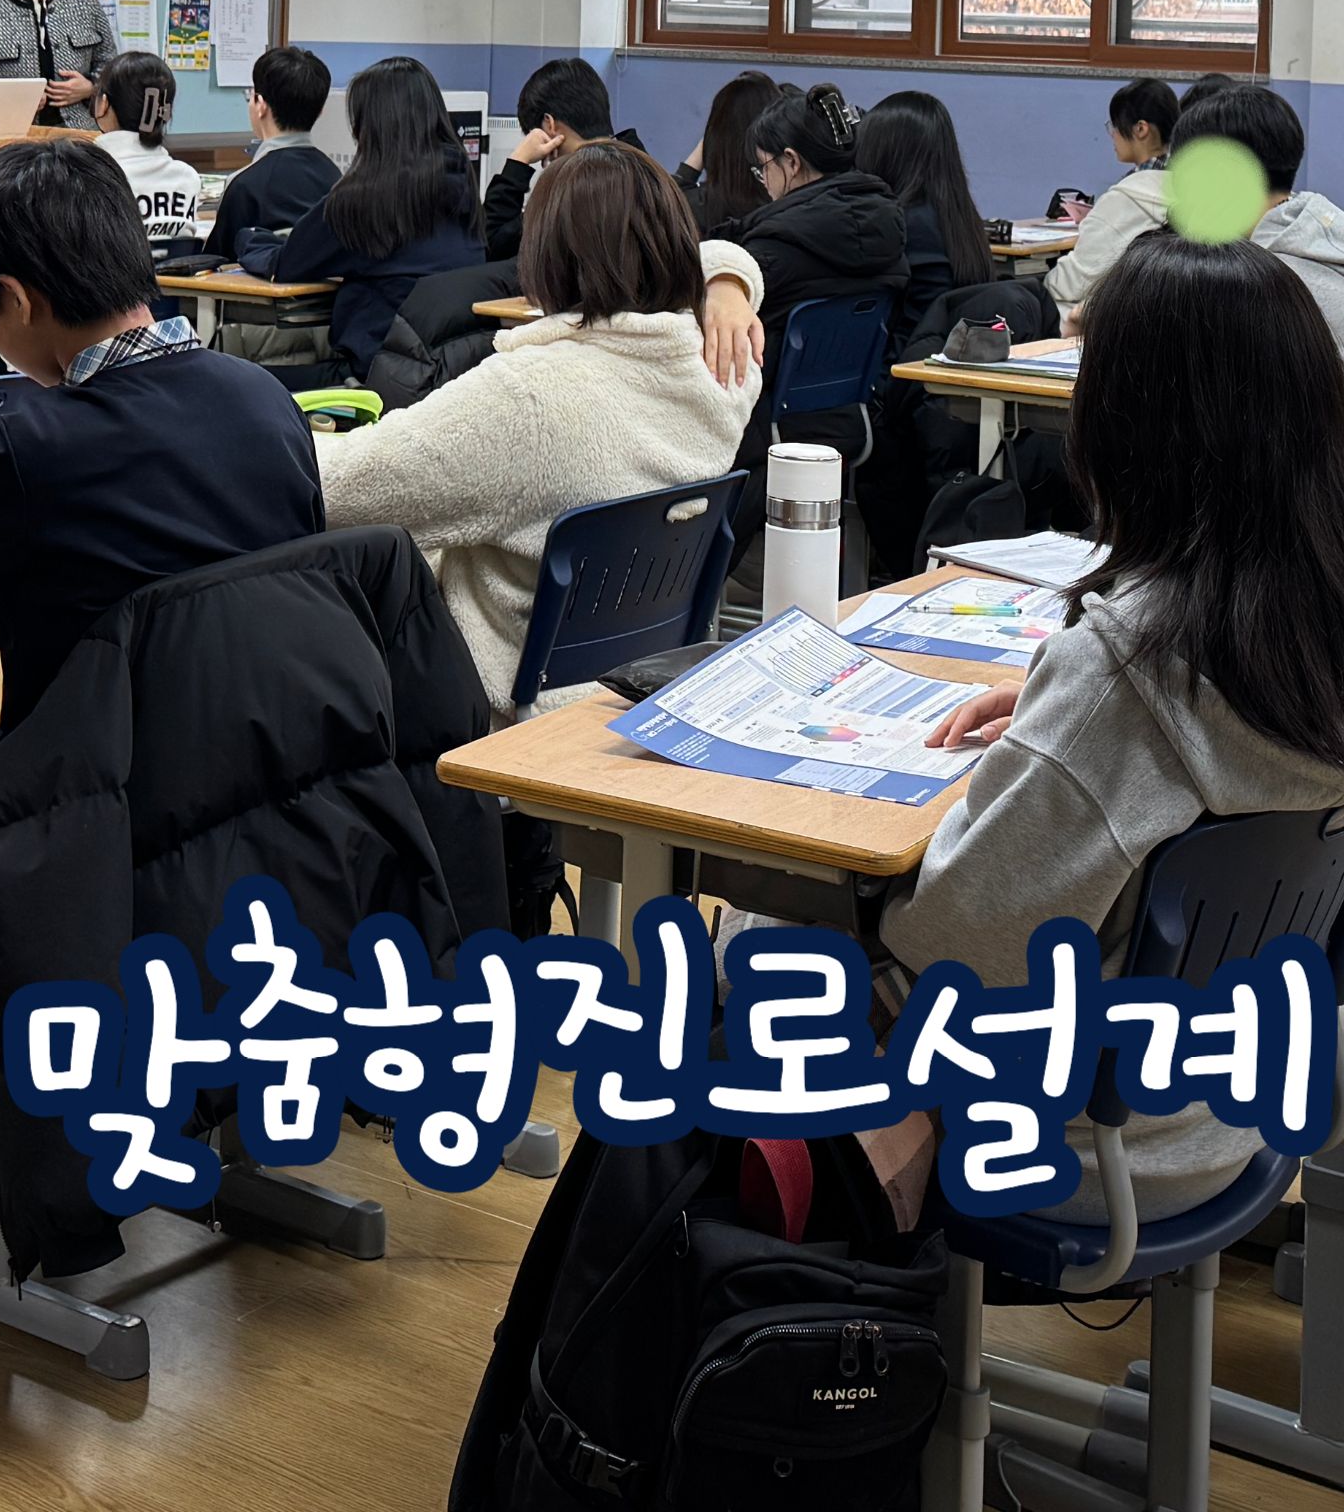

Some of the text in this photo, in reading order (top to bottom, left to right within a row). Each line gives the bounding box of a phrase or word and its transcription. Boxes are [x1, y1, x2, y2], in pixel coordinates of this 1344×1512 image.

[136, 192, 196, 222] OREA
[145, 221, 185, 236] RMY
[813, 1387, 878, 1401] KANGOL
